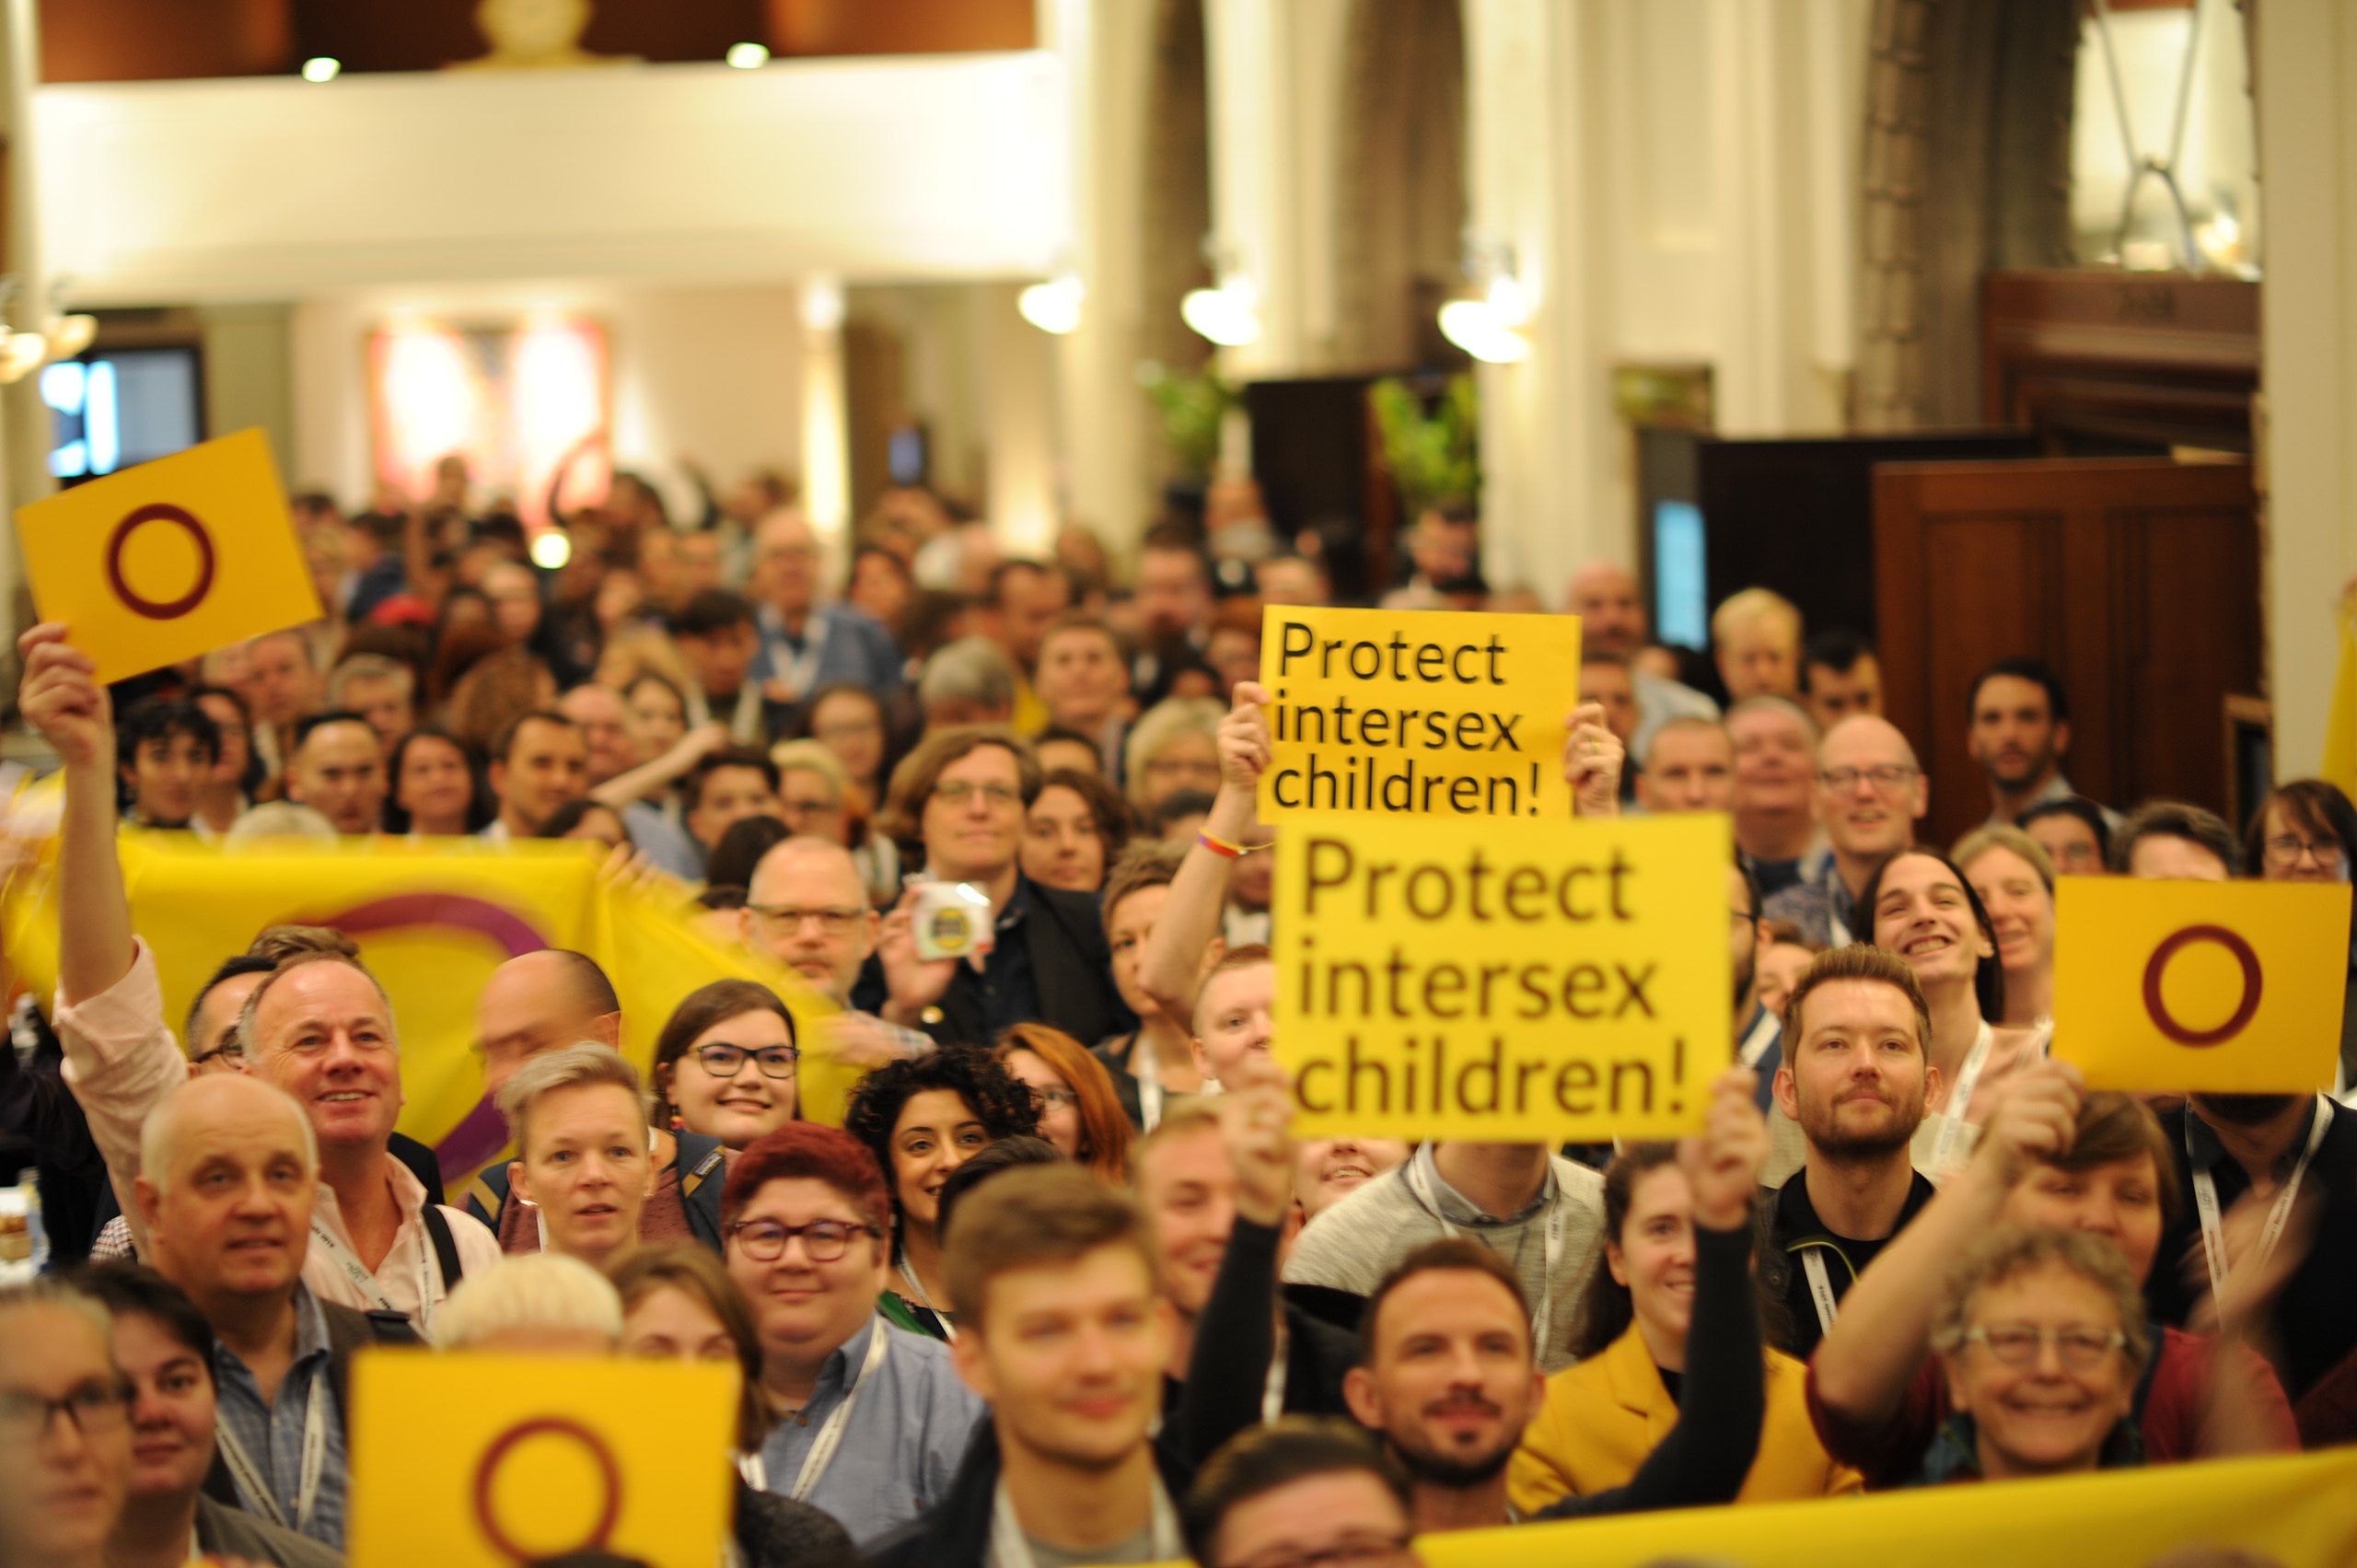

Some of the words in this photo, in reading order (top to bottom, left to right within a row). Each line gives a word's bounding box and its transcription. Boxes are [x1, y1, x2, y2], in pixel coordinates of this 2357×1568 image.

[1278, 621, 1506, 686] Protect
[1274, 689, 1523, 753] intersex
[1271, 752, 1540, 817] children!
[1303, 837, 1635, 923] Protect
[1299, 937, 1656, 1019] intersex
[1293, 1036, 1686, 1115] children!
